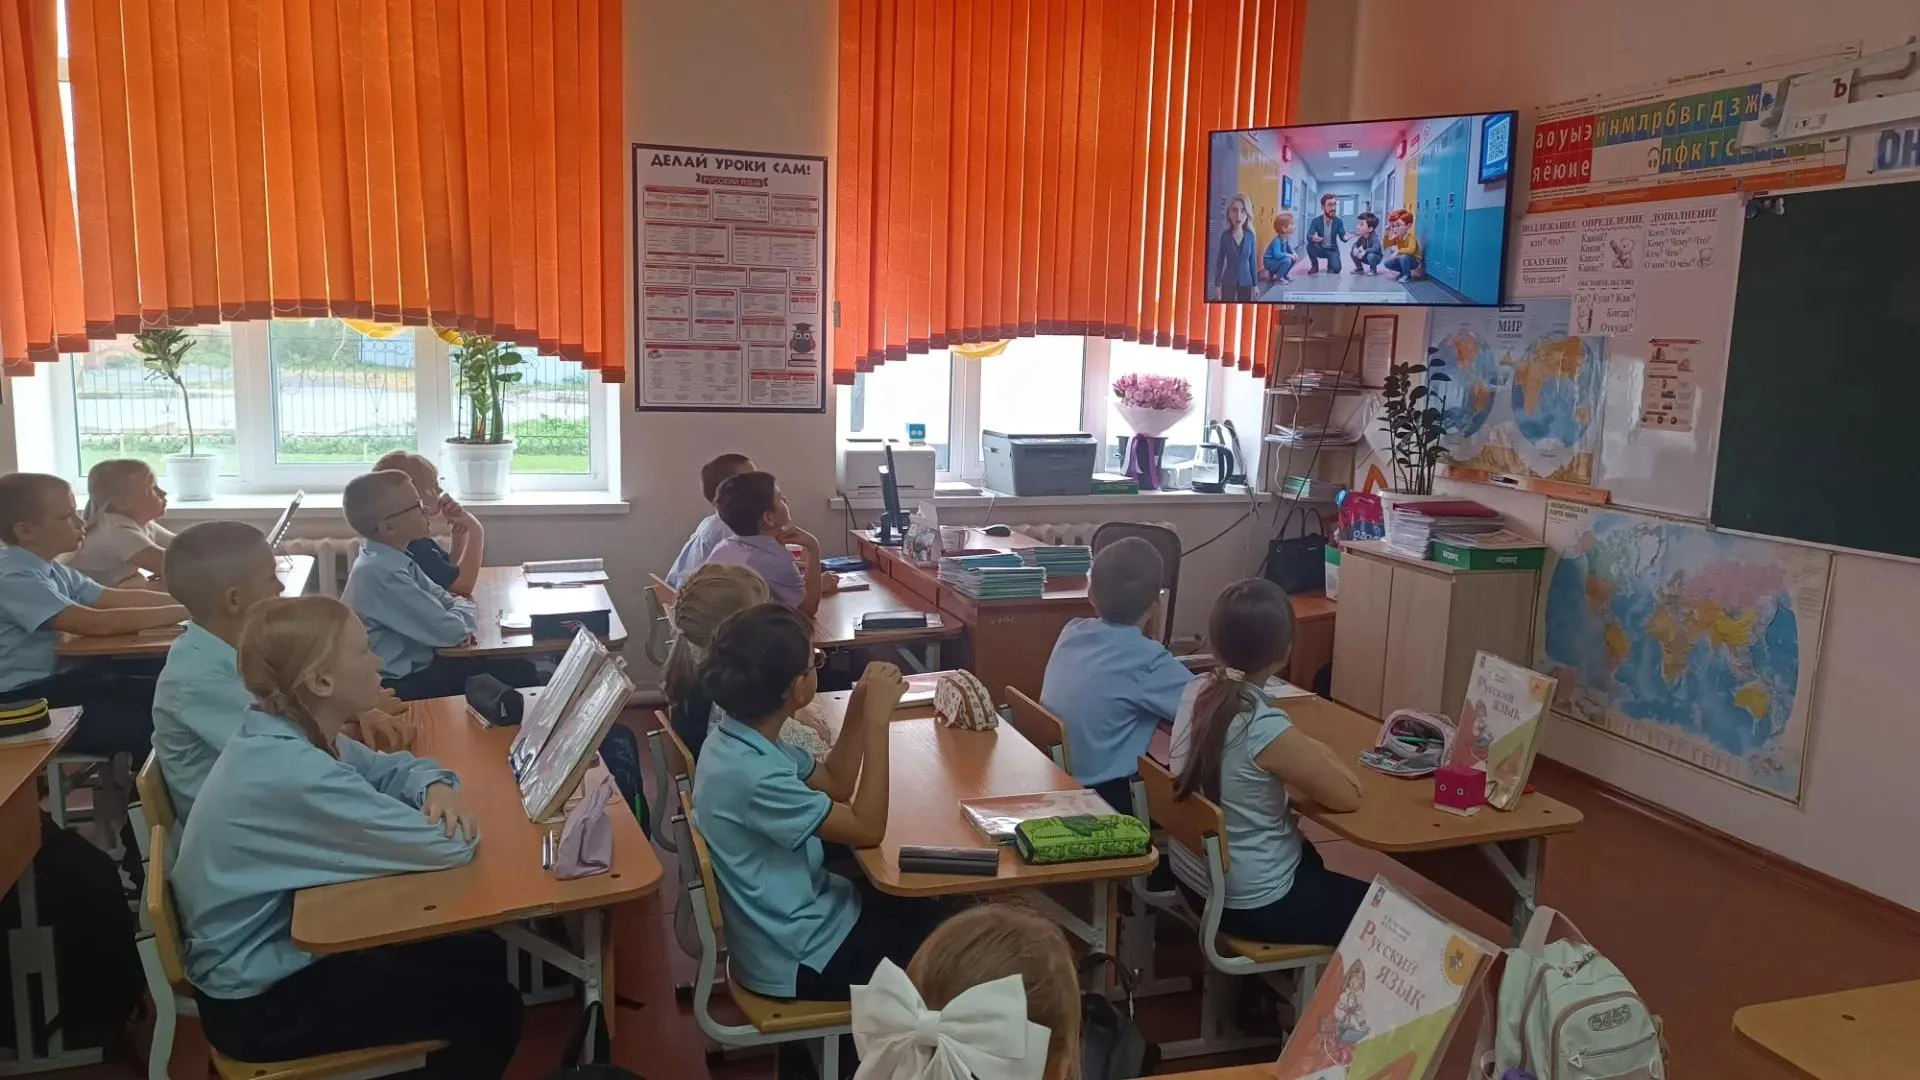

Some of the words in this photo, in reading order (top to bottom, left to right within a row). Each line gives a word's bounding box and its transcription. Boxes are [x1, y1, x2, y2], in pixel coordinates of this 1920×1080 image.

[651, 153, 708, 169] ДЕЛАЙ
[715, 157, 766, 172] УРОКИ
[773, 162, 811, 175] САМ!
[1582, 215, 1645, 227] ОПРЕДЕЛЕНИЕ
[1650, 208, 1719, 221] ДОПОЛНЕНИЕ
[1522, 256, 1568, 266] СКАЗУЕМОЕ
[1498, 320, 1523, 332] МИР
[1478, 676, 1514, 703] Русский
[1358, 919, 1418, 976] Русский
